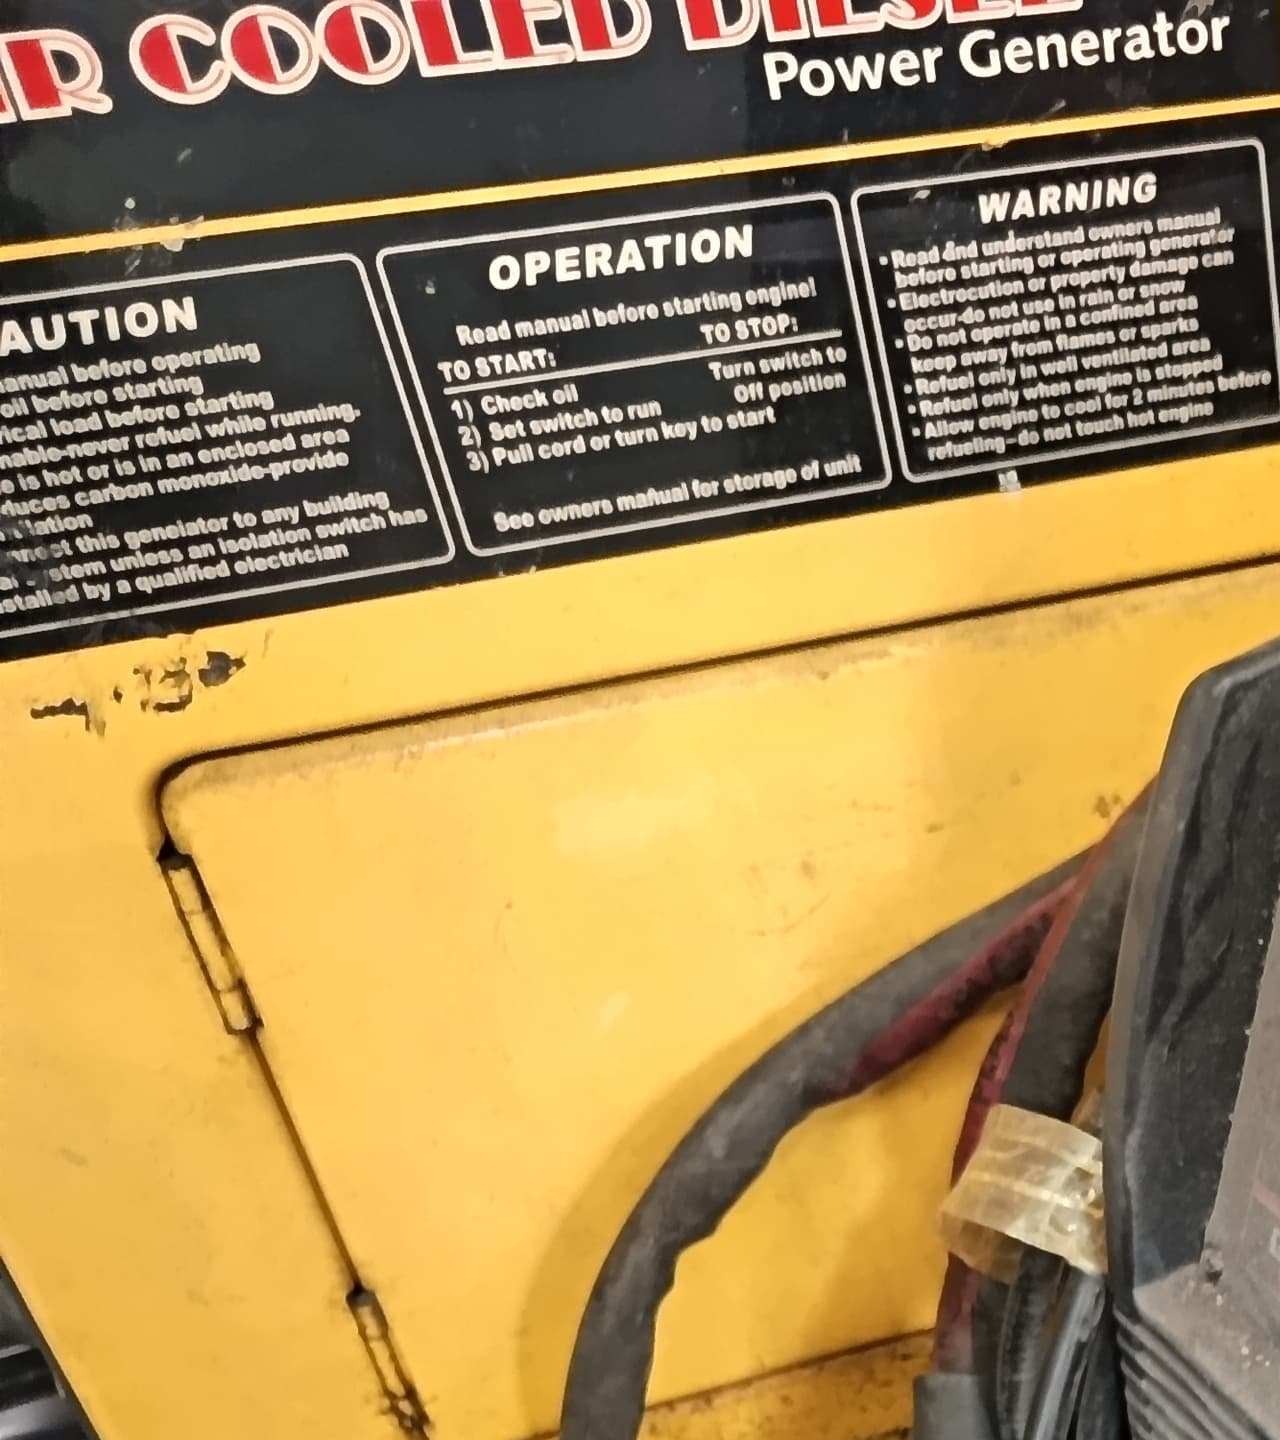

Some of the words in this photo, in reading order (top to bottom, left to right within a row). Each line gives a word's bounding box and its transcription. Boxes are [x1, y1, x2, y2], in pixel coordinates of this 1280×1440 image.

[129, 0, 652, 105] COOLED
[763, 46, 943, 100] Power
[959, 11, 1230, 78] Generator
[978, 172, 1157, 224] WARNING
[961, 256, 1034, 279] starting
[1060, 240, 1146, 267] operating
[1150, 227, 1235, 256] generator
[982, 225, 1085, 256] understand
[1157, 206, 1221, 232] manual
[489, 224, 753, 290] OPERATION
[456, 320, 511, 346] Read
[514, 308, 591, 338] manual
[592, 301, 659, 327] before
[662, 291, 742, 318] starting
[700, 322, 731, 344] TO
[734, 313, 799, 340] STOP:
[907, 334, 933, 352] Do
[0, 366, 69, 393] anual
[71, 358, 147, 382] before
[152, 343, 261, 373] operating
[437, 360, 471, 382] TO
[475, 348, 557, 377] START:
[708, 361, 756, 381] Turn
[759, 348, 824, 374] switch
[826, 346, 847, 362] to
[768, 373, 847, 402] position
[31, 389, 108, 413] before
[112, 376, 204, 402] starting
[50, 411, 103, 436] load
[104, 405, 180, 428] before
[184, 391, 274, 415] starting
[481, 388, 549, 415] Check
[135, 422, 201, 448] refuel
[205, 415, 266, 438] while
[488, 419, 527, 441] Set
[529, 407, 599, 435] switch
[601, 405, 624, 424] to
[627, 400, 662, 420] run
[492, 442, 535, 467] Pull
[538, 434, 587, 459] cord
[590, 434, 611, 451] or
[614, 427, 659, 447] turn
[661, 420, 698, 441] key
[701, 415, 723, 433] to
[726, 405, 776, 429] start
[42, 466, 84, 487] hot
[166, 452, 194, 469] an
[198, 433, 297, 463] enclosed
[300, 428, 350, 448] area
[74, 482, 154, 506] carbon
[494, 510, 534, 533] See
[538, 498, 613, 525] owners
[723, 467, 797, 494] storage
[824, 453, 862, 478] unit
[75, 532, 120, 553] this
[233, 512, 257, 528] to
[262, 506, 299, 525] any
[303, 491, 390, 517] building
[110, 549, 184, 572] unless
[188, 542, 215, 559] an
[218, 527, 311, 554] isolation
[315, 513, 387, 539] switch
[388, 508, 428, 527] has
[0, 584, 80, 614] stalled
[82, 582, 110, 601] by
[135, 560, 230, 594] qualified
[234, 543, 349, 575] electrician
